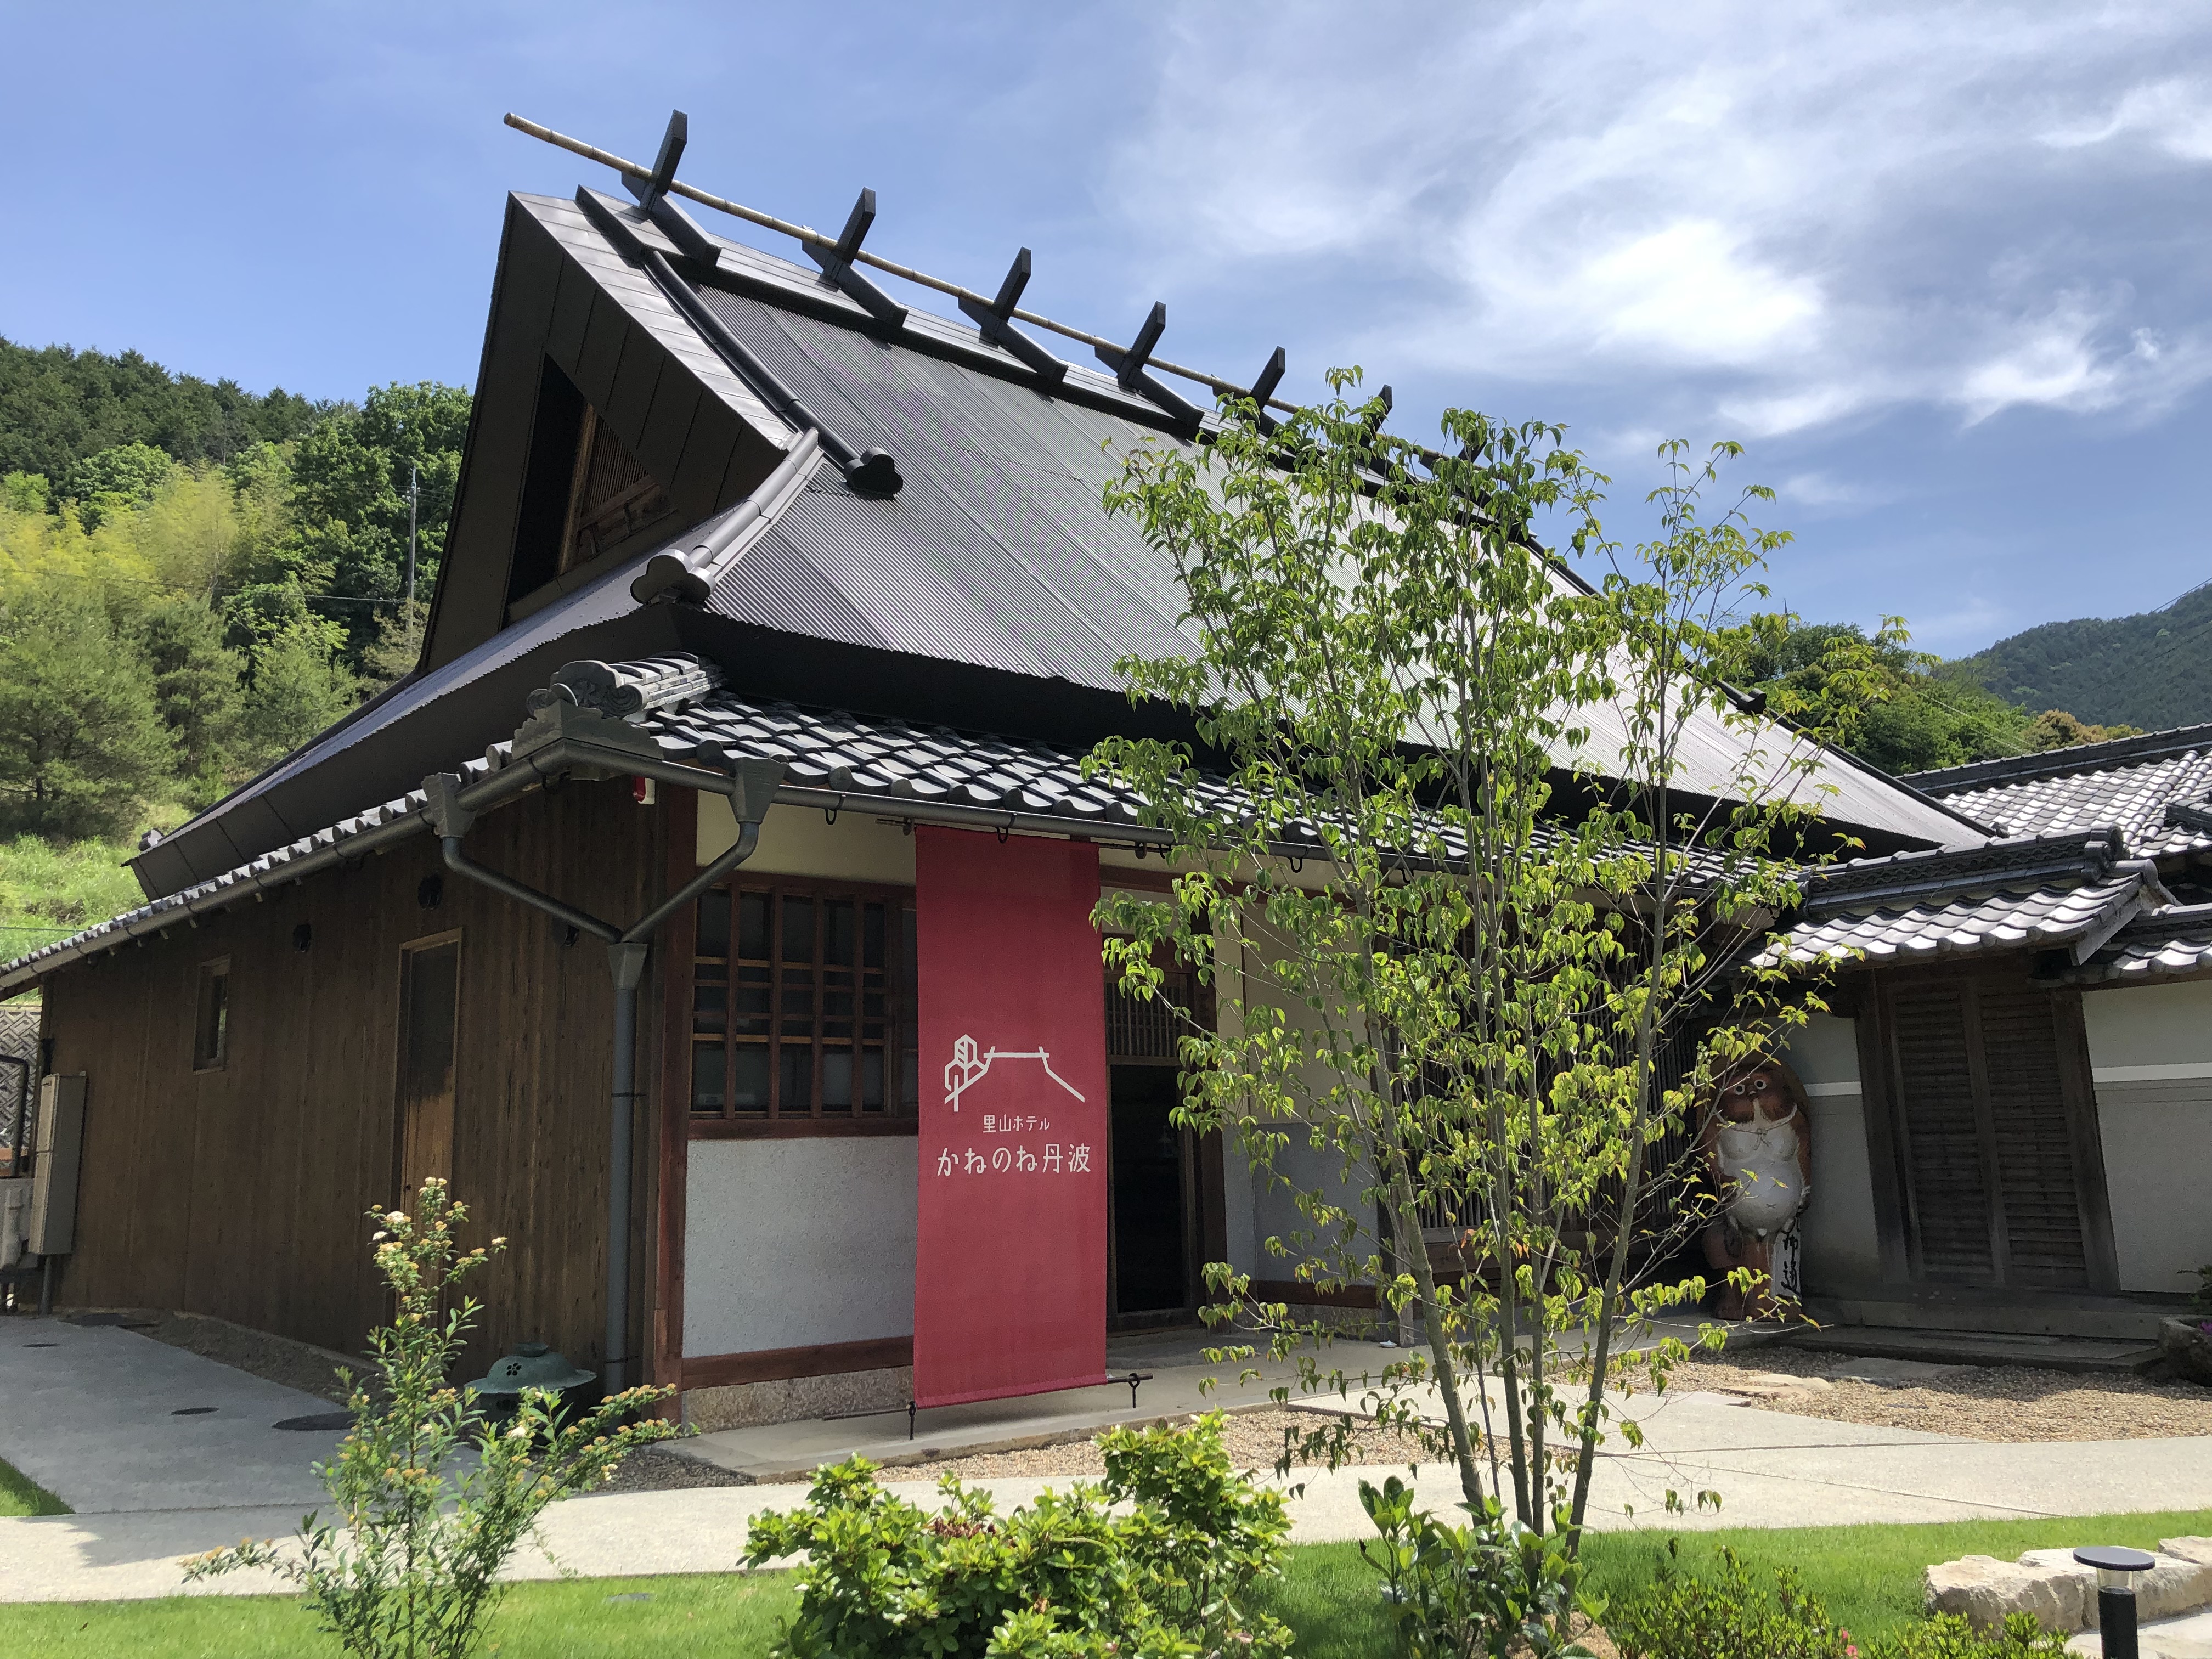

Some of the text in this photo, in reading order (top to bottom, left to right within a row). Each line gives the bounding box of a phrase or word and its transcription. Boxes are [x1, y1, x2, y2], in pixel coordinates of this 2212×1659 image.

[983, 1114, 1050, 1133] 里山ホテル
[937, 1143, 1091, 1176] かねのね丹波
